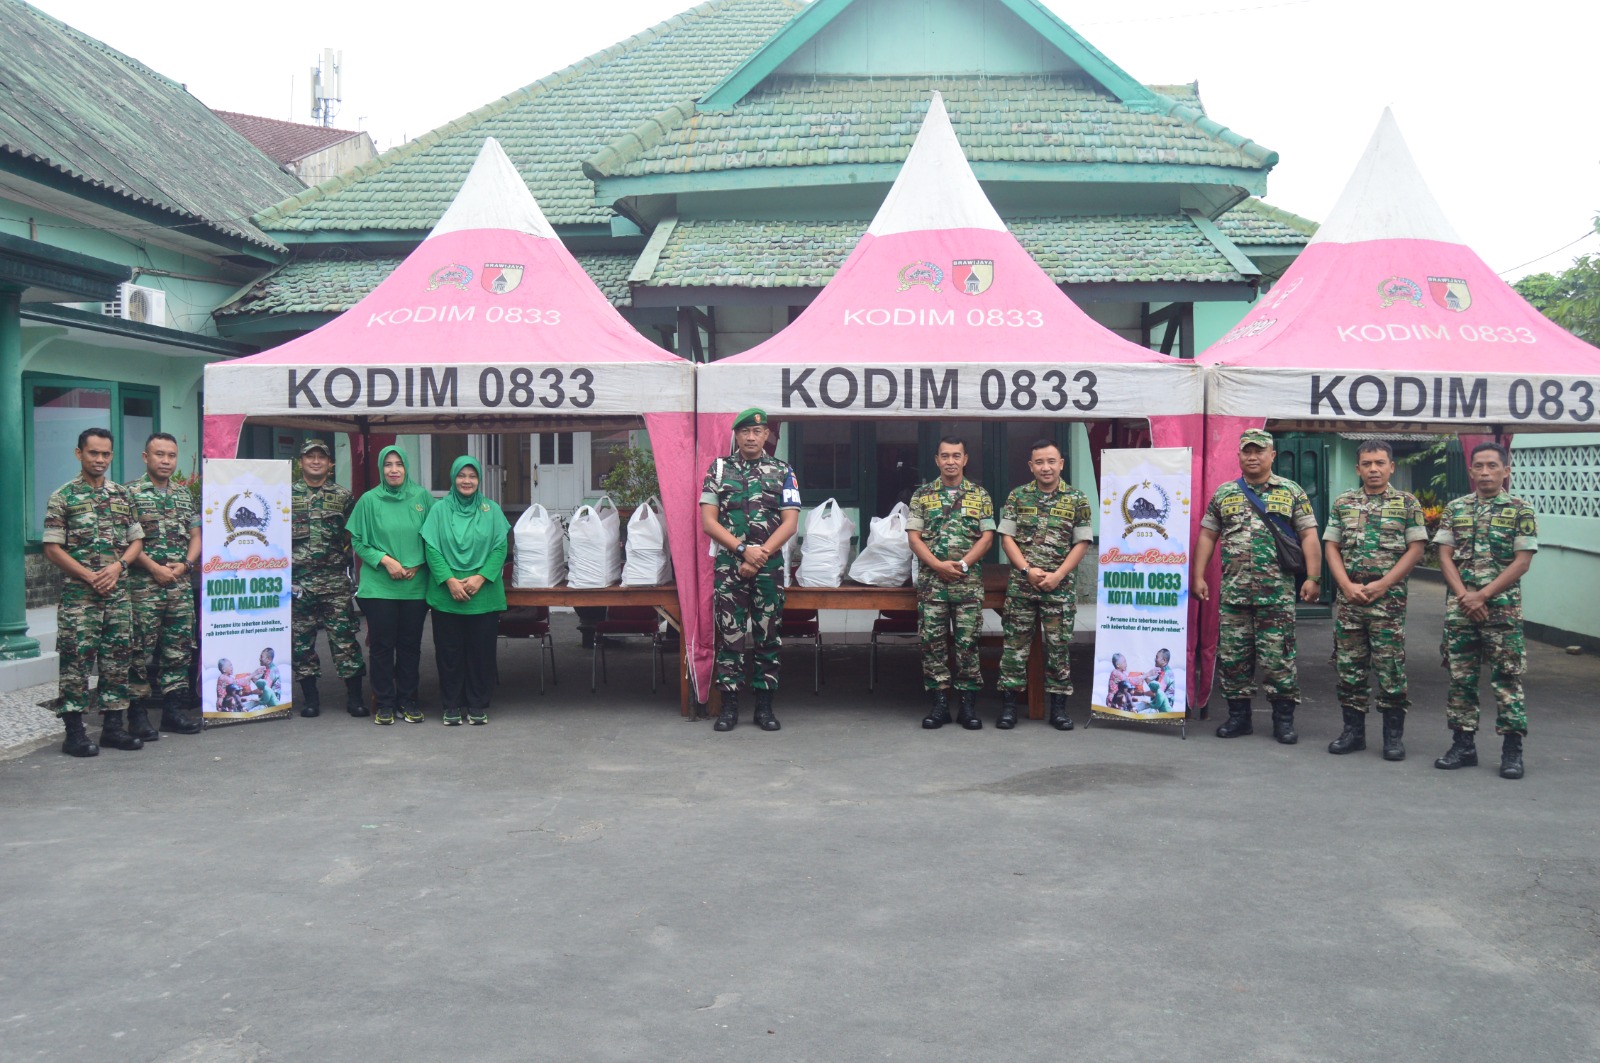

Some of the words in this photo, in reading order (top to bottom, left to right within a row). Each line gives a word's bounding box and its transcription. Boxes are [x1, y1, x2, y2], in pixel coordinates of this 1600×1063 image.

[366, 306, 475, 328] KODIM
[485, 306, 562, 326] 0833
[843, 308, 956, 327] KODIM
[966, 308, 1044, 328] 0833
[1337, 324, 1451, 343] KODIM
[1461, 324, 1537, 344] 0833
[288, 367, 458, 409] KODIM
[478, 367, 596, 409] 0833
[781, 367, 959, 410] KODIM
[980, 368, 1099, 411] 0833
[1310, 374, 1488, 419] KODIM
[1508, 378, 1600, 422] 083
[783, 488, 801, 504] PR
[203, 556, 244, 573] Jumat
[245, 555, 288, 570] Berkah
[1100, 547, 1143, 564] Jumat
[1143, 549, 1187, 564] Berkah
[207, 578, 246, 596] KODIM
[250, 577, 282, 593] 0833
[1103, 571, 1144, 589] KODIM
[1148, 572, 1181, 590] 0833
[211, 597, 235, 611] KOTA
[238, 595, 279, 610] MALANG
[1108, 590, 1133, 605] KOTA
[1135, 591, 1178, 607] MALANG
